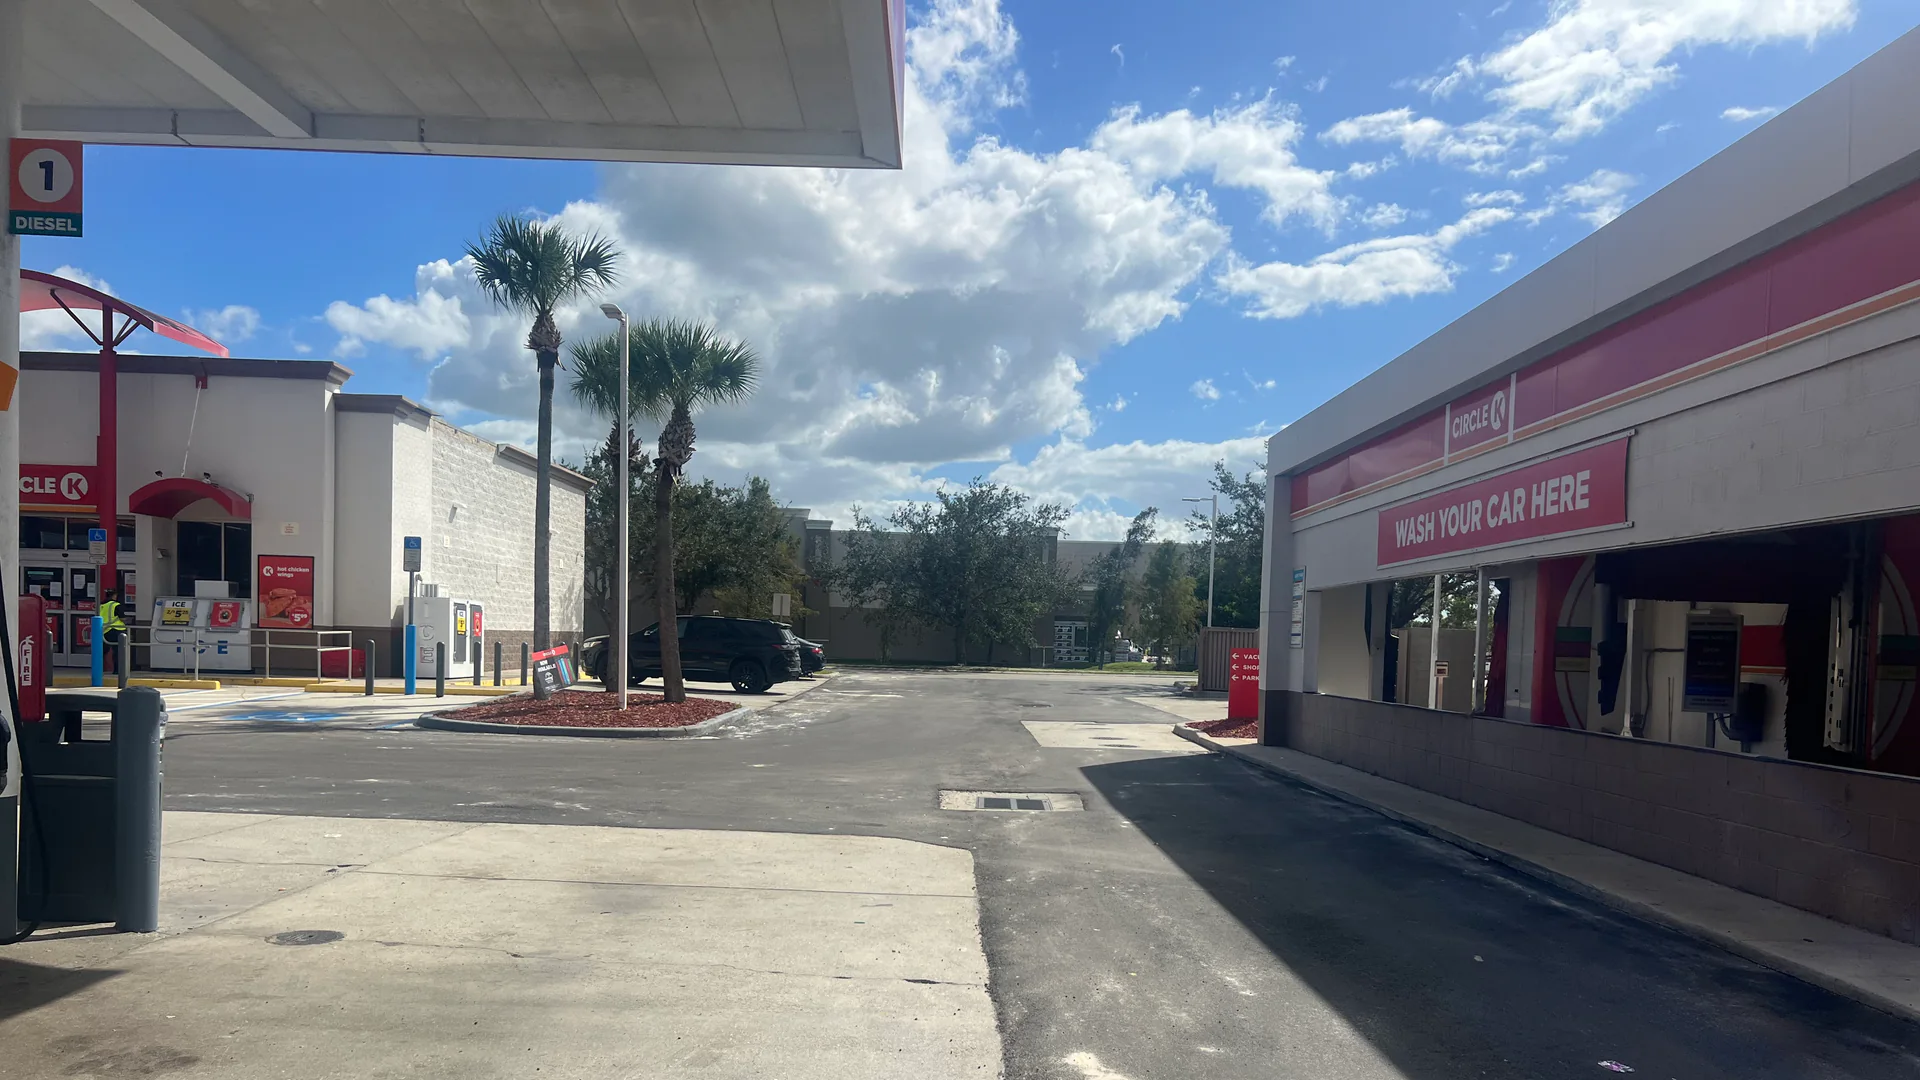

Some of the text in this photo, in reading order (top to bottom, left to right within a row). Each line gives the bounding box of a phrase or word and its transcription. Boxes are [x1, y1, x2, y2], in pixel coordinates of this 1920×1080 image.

[38, 160, 54, 191] 1
[15, 216, 77, 231] DIESEL
[1452, 390, 1506, 439] CIRCLE K
[60, 472, 89, 500] K
[1395, 469, 1590, 548] WASH YOUR CAR HERE
[23, 649, 31, 681] FIRE
